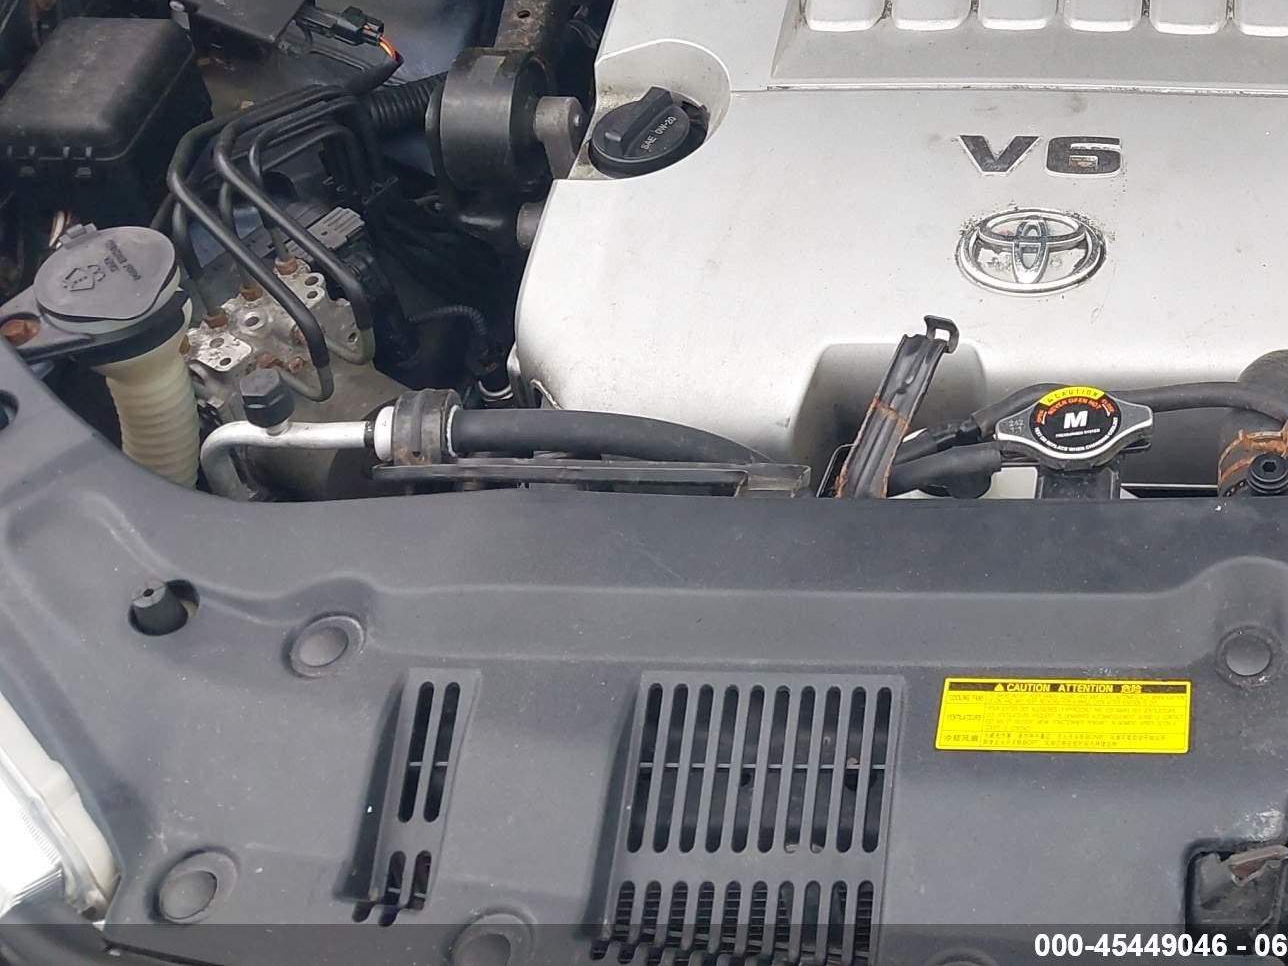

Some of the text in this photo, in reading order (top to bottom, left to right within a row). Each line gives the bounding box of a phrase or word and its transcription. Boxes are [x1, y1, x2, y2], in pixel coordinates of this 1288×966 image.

[640, 135, 657, 150] SAE
[957, 134, 1123, 177] V6
[1063, 410, 1088, 429] M
[1007, 684, 1114, 693] CAUTION ATTENTION
